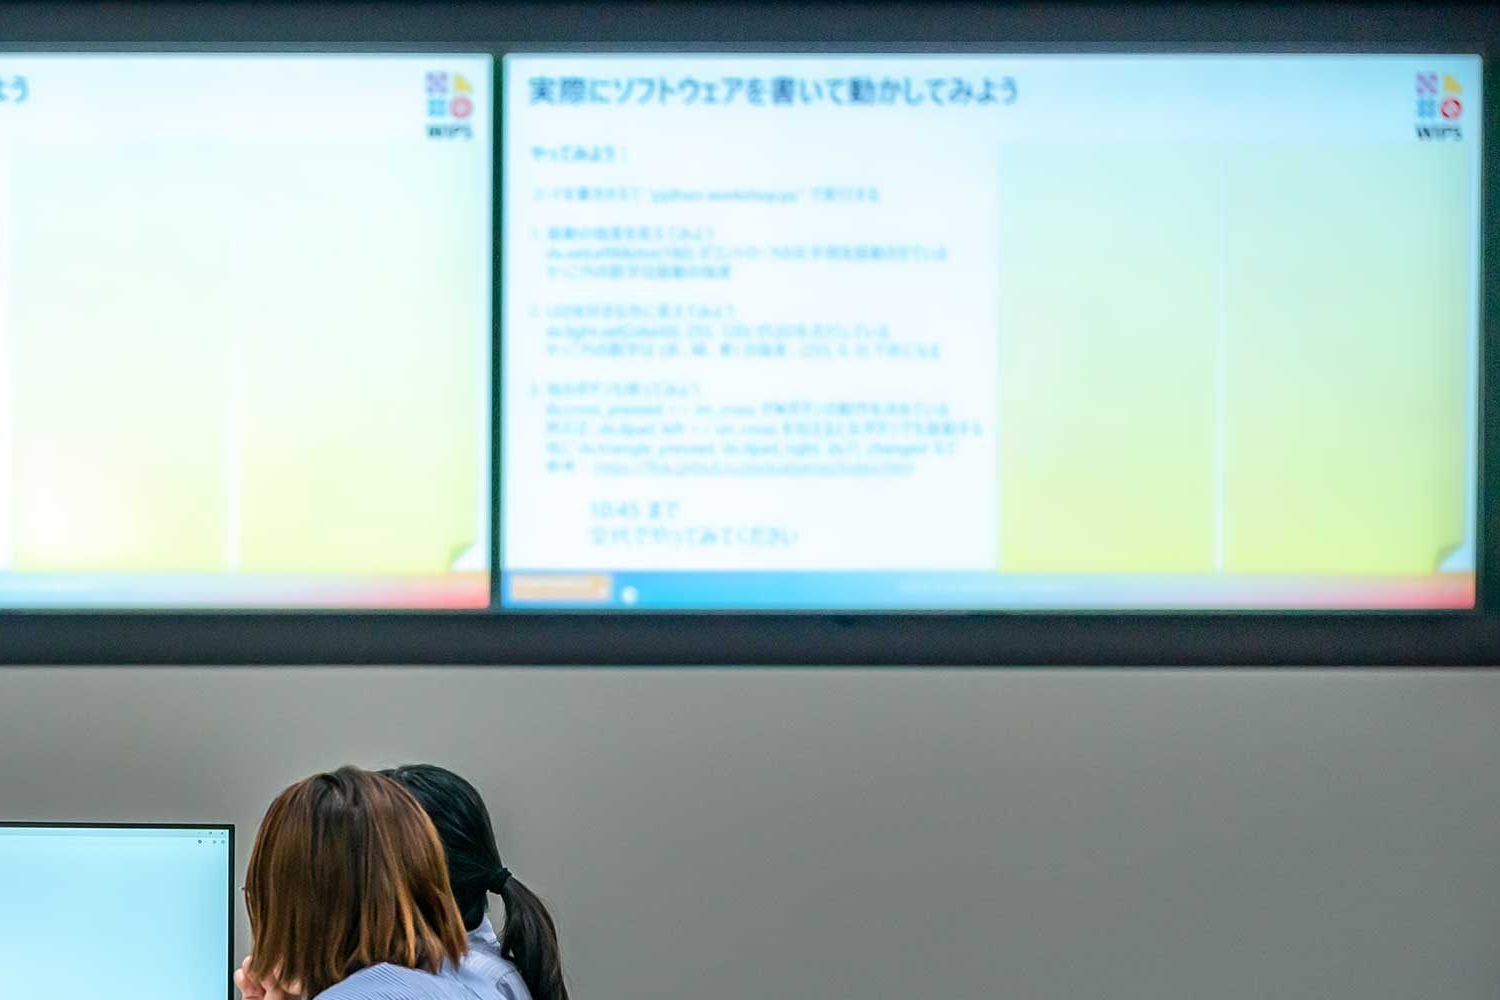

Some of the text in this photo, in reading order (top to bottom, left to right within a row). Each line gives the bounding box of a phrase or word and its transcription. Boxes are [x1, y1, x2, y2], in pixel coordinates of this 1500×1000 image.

[527, 76, 1018, 107] 実際にソフトウェアを書いて動かしてみよう
[1417, 125, 1462, 140] WIPS
[588, 501, 681, 519] 10:45 まで
